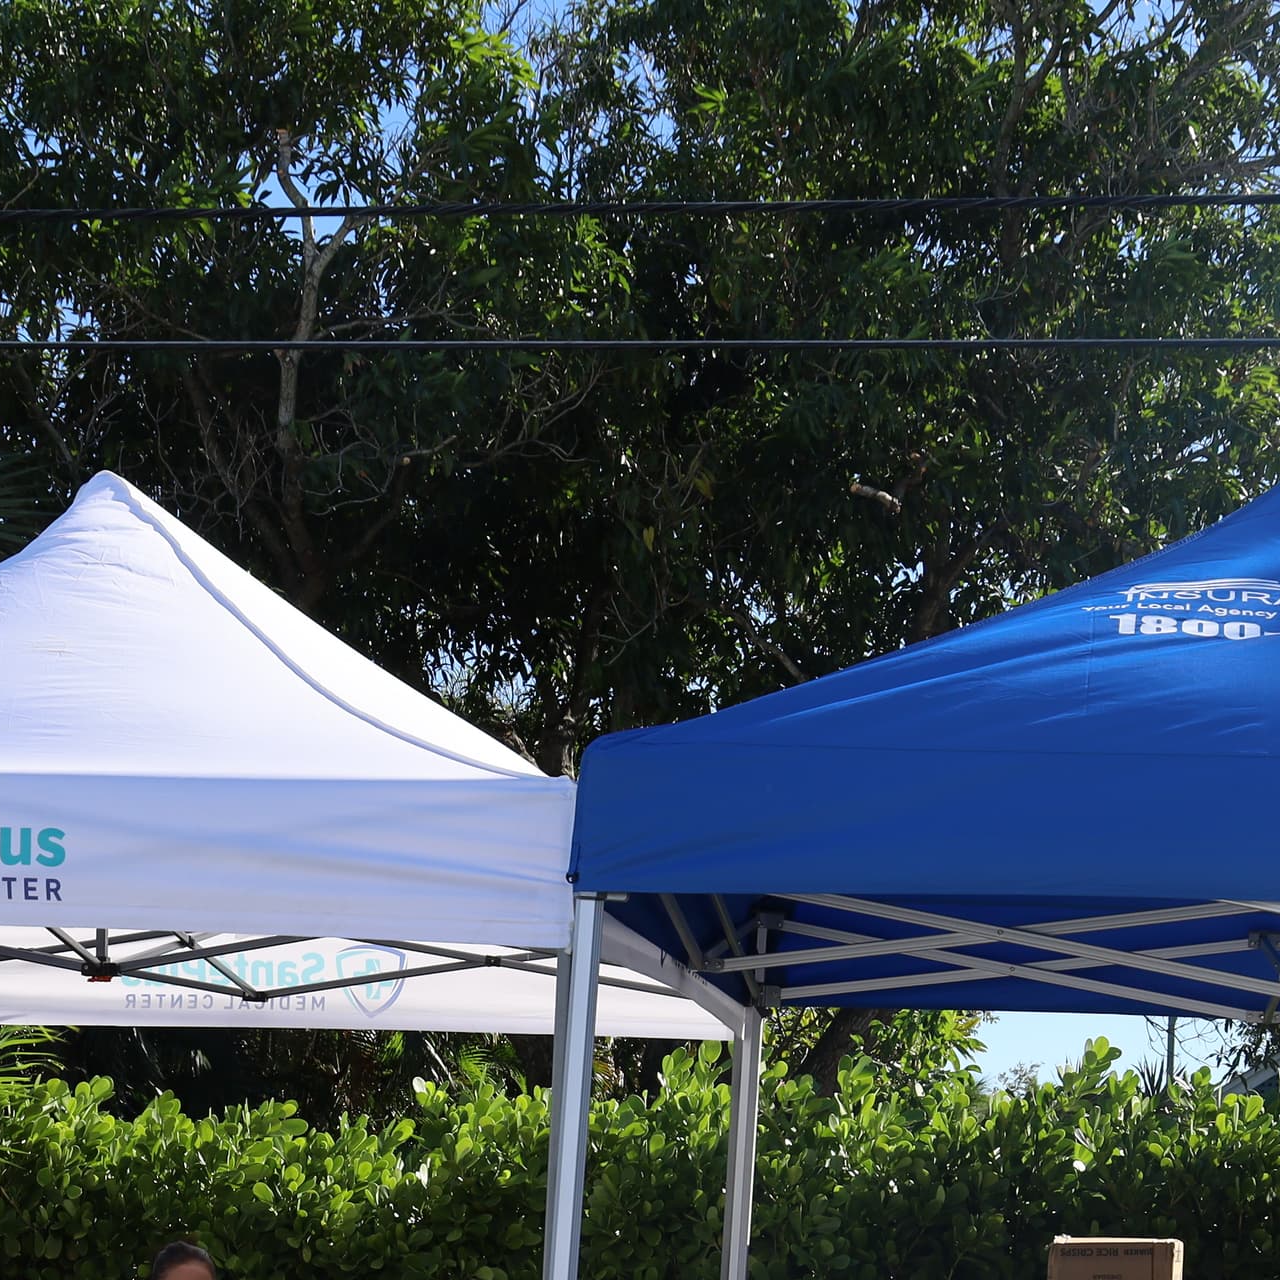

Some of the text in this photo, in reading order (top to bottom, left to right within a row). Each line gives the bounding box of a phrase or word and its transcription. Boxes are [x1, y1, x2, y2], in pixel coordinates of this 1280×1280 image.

[1137, 602, 1191, 612] Local
[1198, 602, 1277, 619] Agency
[1060, 1248, 1094, 1257] CRISPS
[1096, 1248, 1119, 1257] RICE
